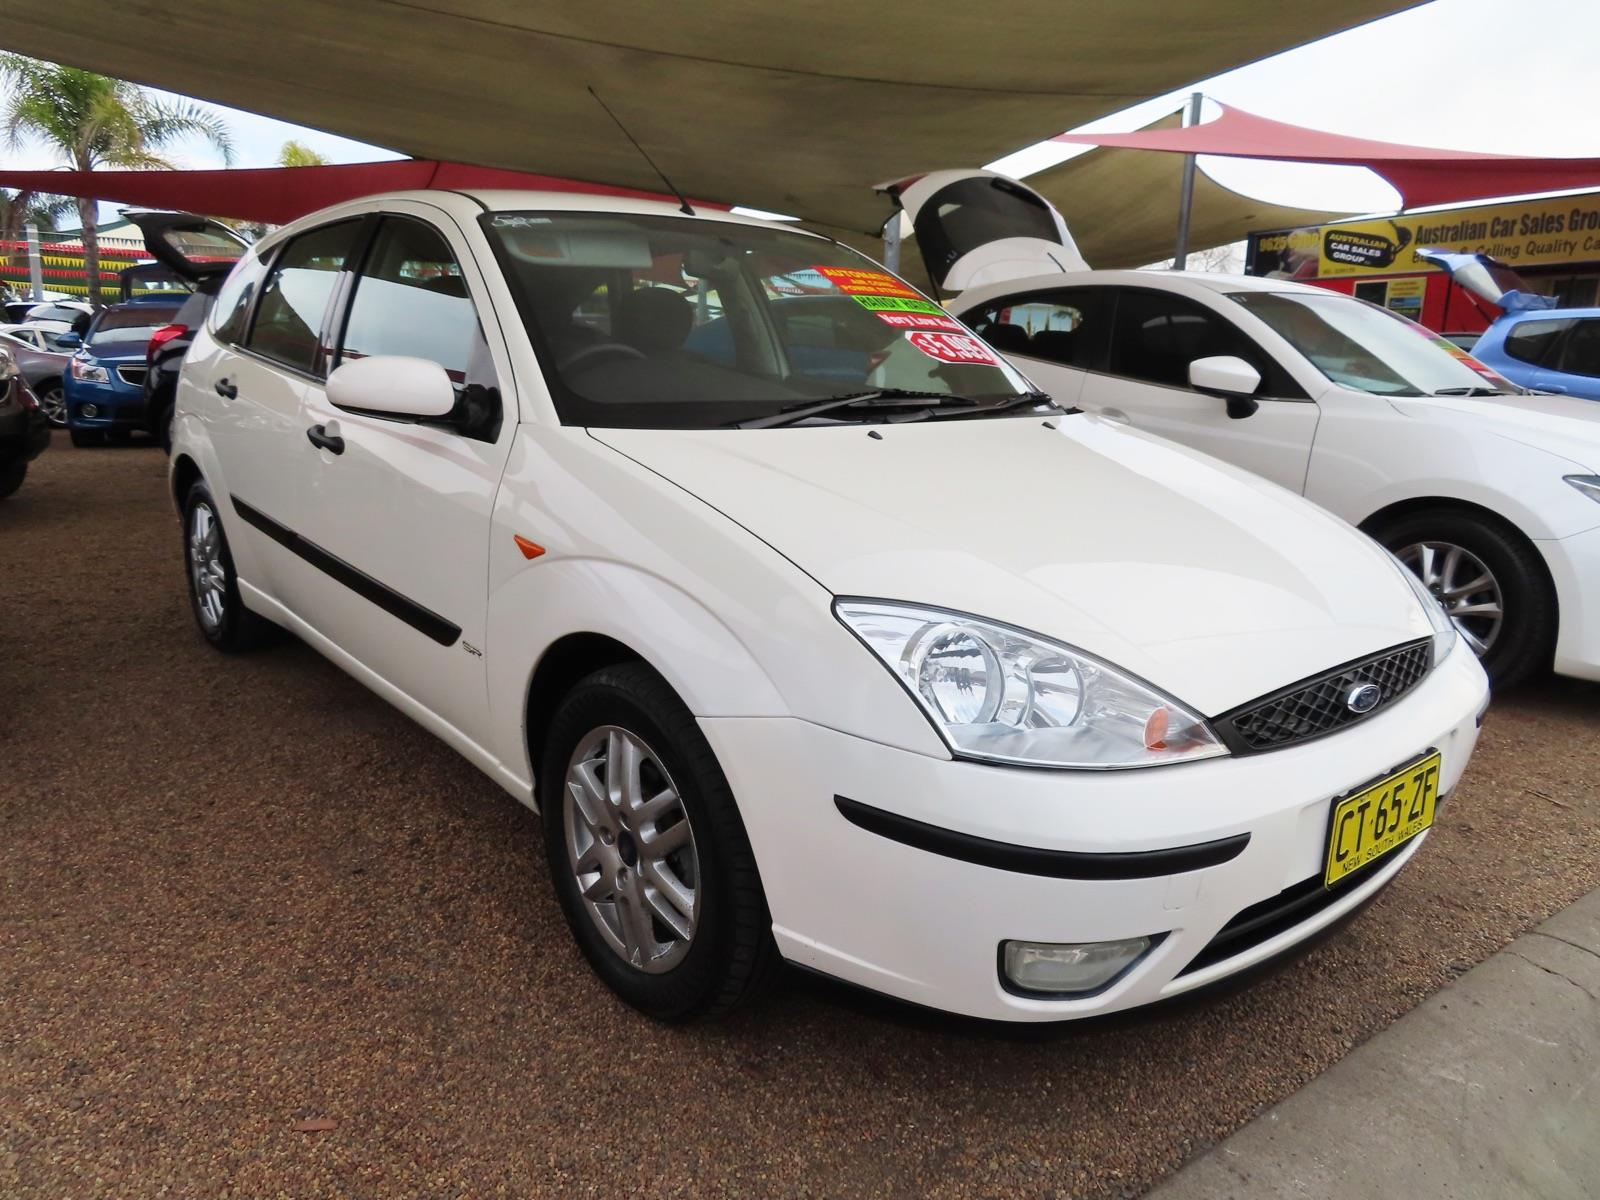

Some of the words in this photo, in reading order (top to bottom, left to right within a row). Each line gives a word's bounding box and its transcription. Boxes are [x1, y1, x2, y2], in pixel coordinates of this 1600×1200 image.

[1415, 221, 1487, 245] Australian
[1491, 216, 1517, 238] Car
[1520, 212, 1565, 236] Sales
[1569, 208, 1600, 232] Gro
[1329, 233, 1388, 249] AUSTRALIAN
[1331, 242, 1350, 252] CAR
[1351, 246, 1381, 257] SALES
[1526, 239, 1578, 257] Quality
[1333, 251, 1365, 263] GROUP
[1343, 856, 1361, 872] NEW
[1366, 838, 1394, 860] SOUTH
[1398, 818, 1423, 840] WALES
